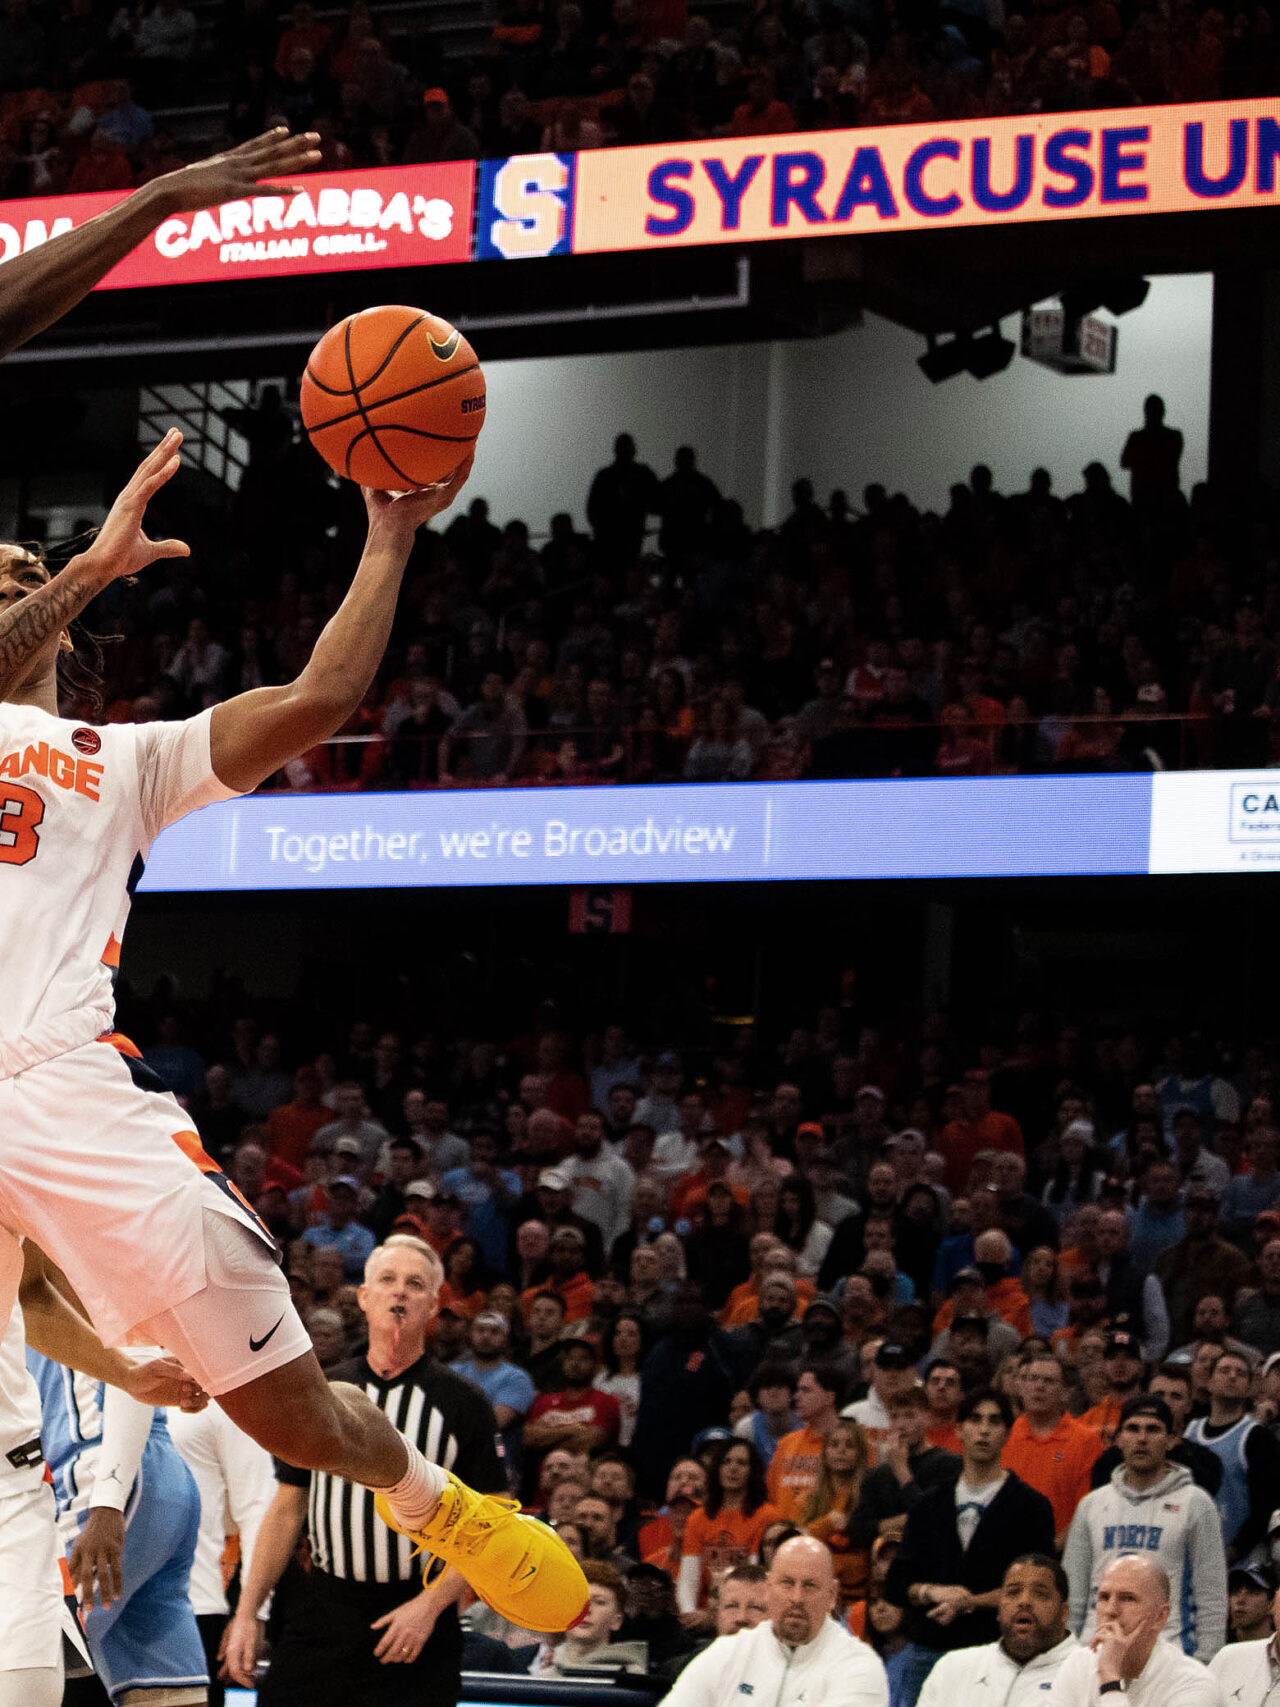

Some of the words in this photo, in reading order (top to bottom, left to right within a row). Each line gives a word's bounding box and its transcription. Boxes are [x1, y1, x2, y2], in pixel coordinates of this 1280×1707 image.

[646, 126, 1149, 235] SYRACUSE
[155, 188, 453, 257] CARRABBA'S
[220, 238, 308, 262] ITALIAN
[313, 232, 384, 255] GRILL
[265, 824, 429, 873] Together,
[439, 821, 532, 860] we're
[543, 815, 735, 857] Broadview
[1103, 1525, 1163, 1551] NORTH
